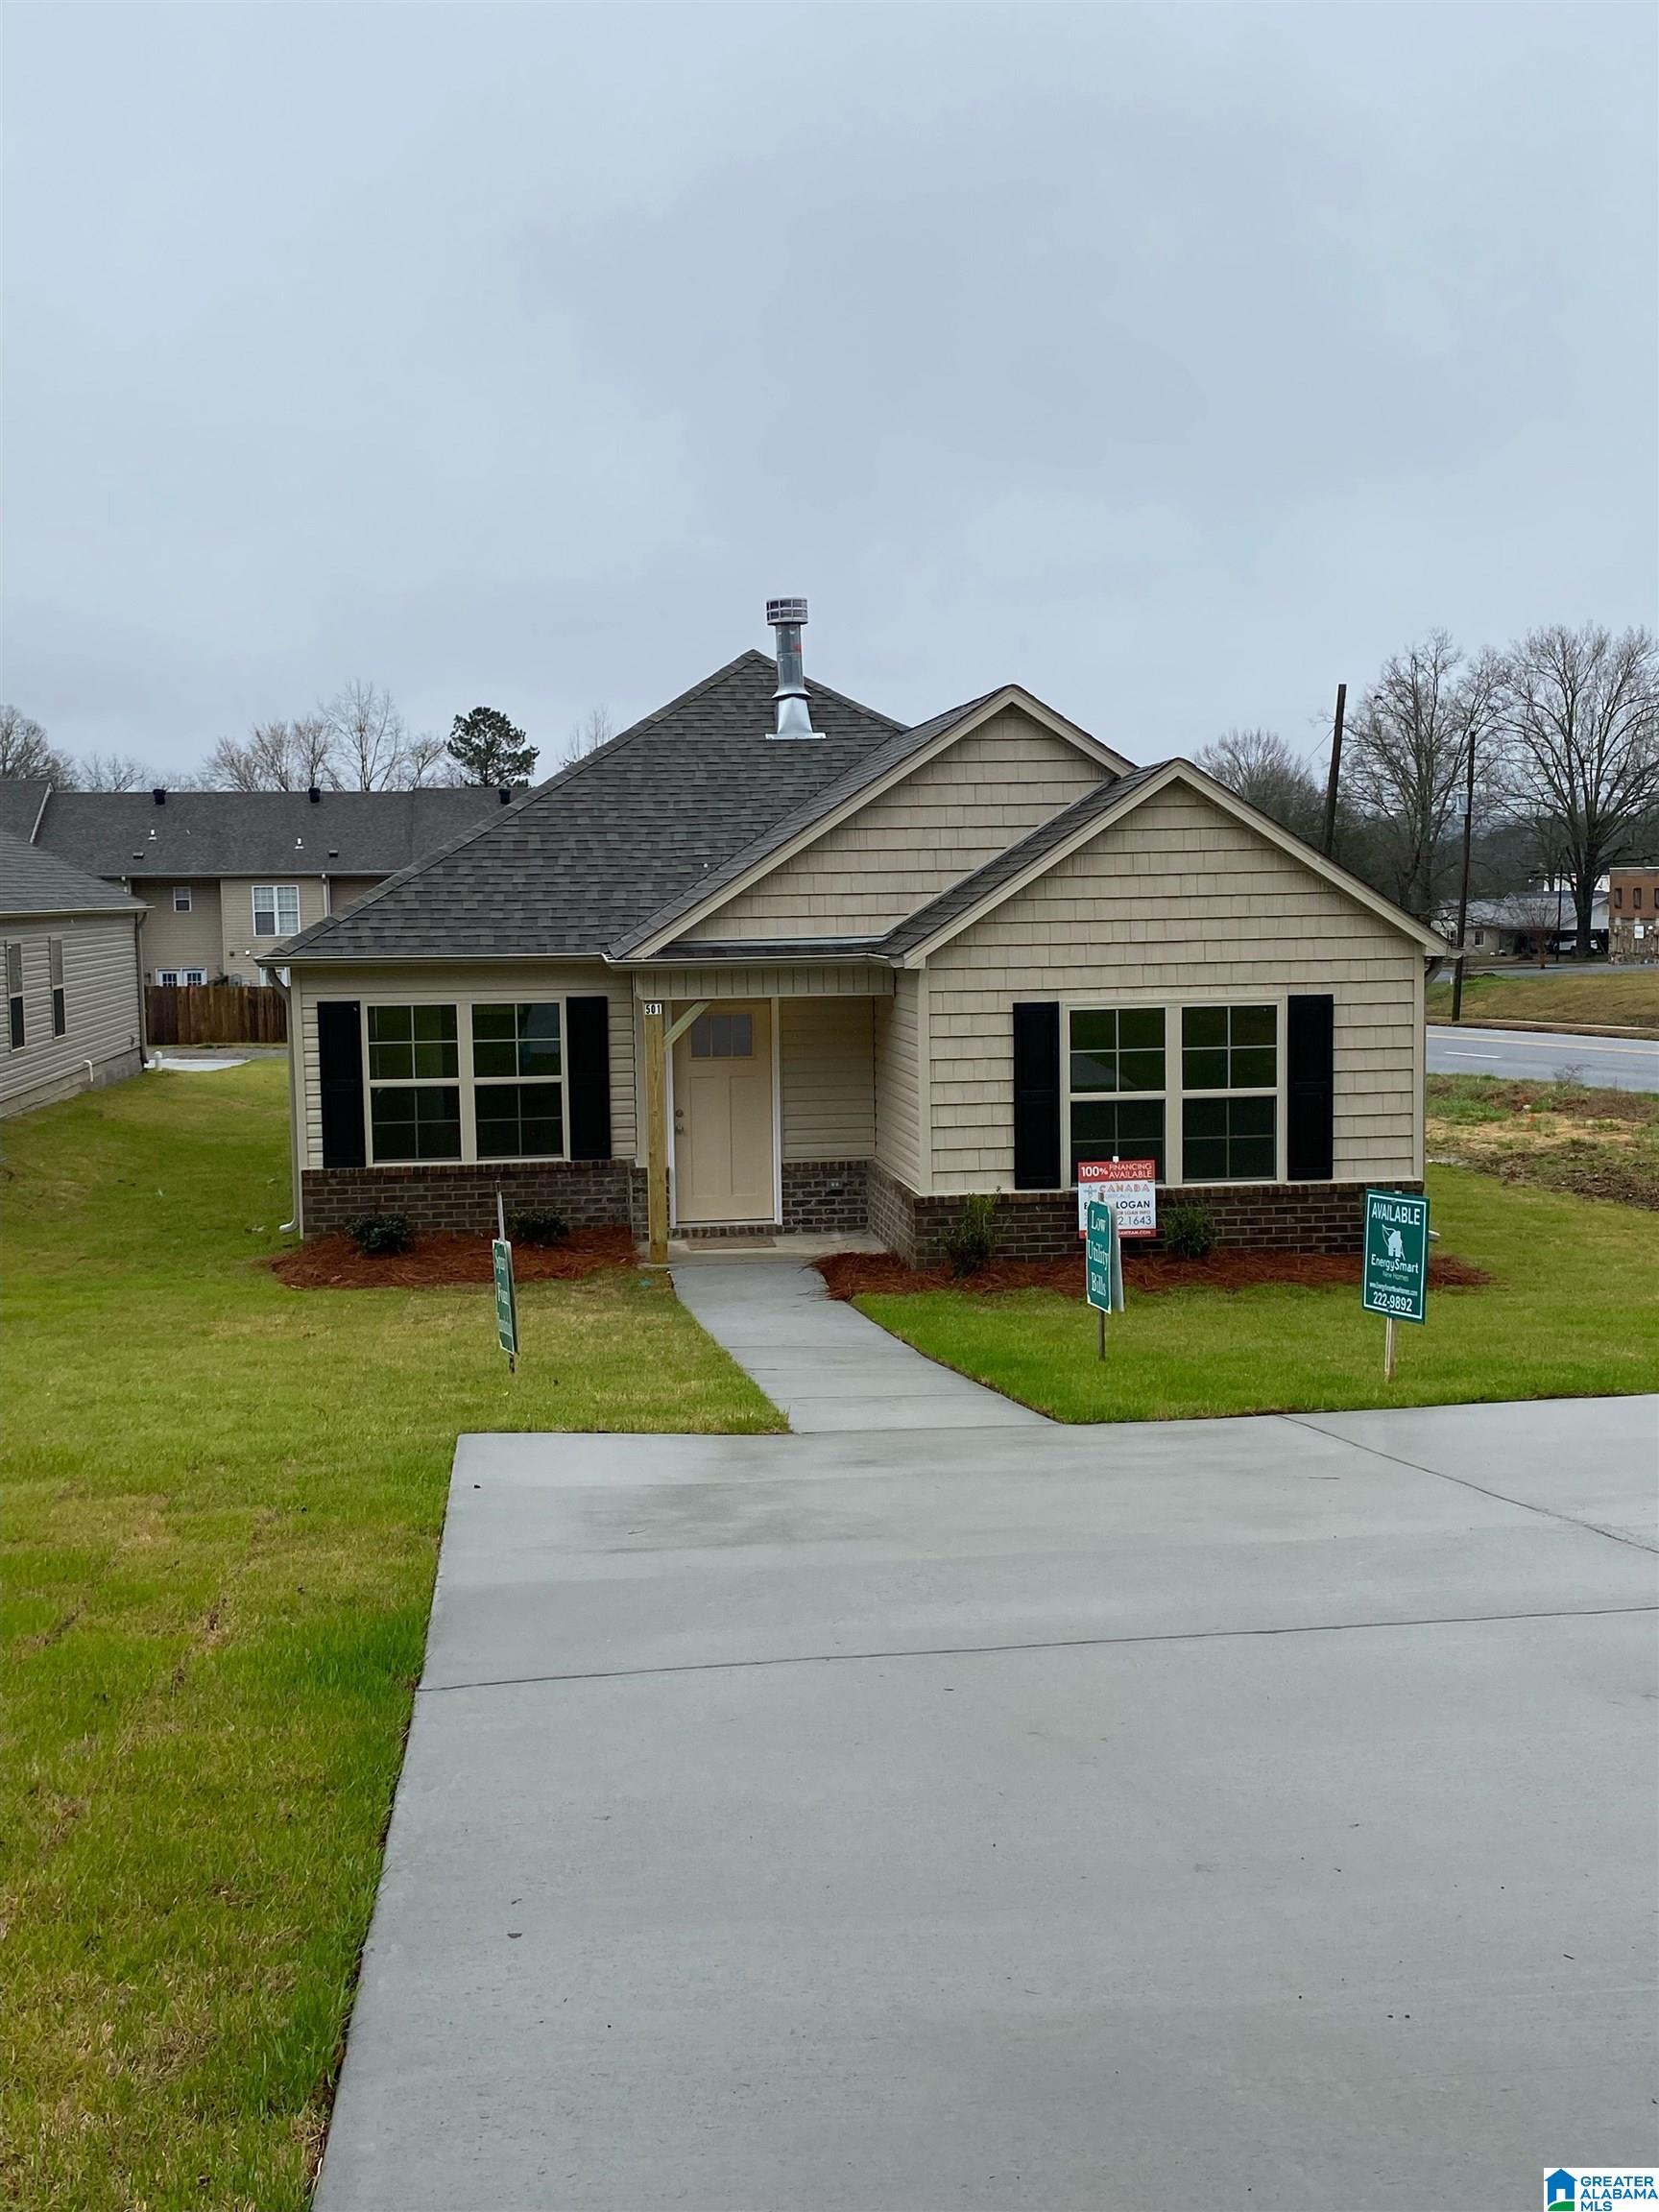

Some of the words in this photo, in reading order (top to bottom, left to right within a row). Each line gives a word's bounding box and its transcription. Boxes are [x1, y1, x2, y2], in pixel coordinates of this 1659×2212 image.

[646, 1004, 660, 1015] 501
[1081, 1166, 1108, 1177] 100%
[1109, 1163, 1152, 1171] FINANCING
[1109, 1170, 1152, 1179] AVAILABLE
[1116, 1200, 1150, 1209] LOGAN
[1371, 1202, 1421, 1225] AVAILABLE
[1091, 1210, 1107, 1233] Low
[1088, 1239, 1108, 1270] Utility
[1371, 1254, 1419, 1274] EnergySmart
[1091, 1271, 1107, 1296] Bills
[1373, 1291, 1412, 1312] 222-9892
